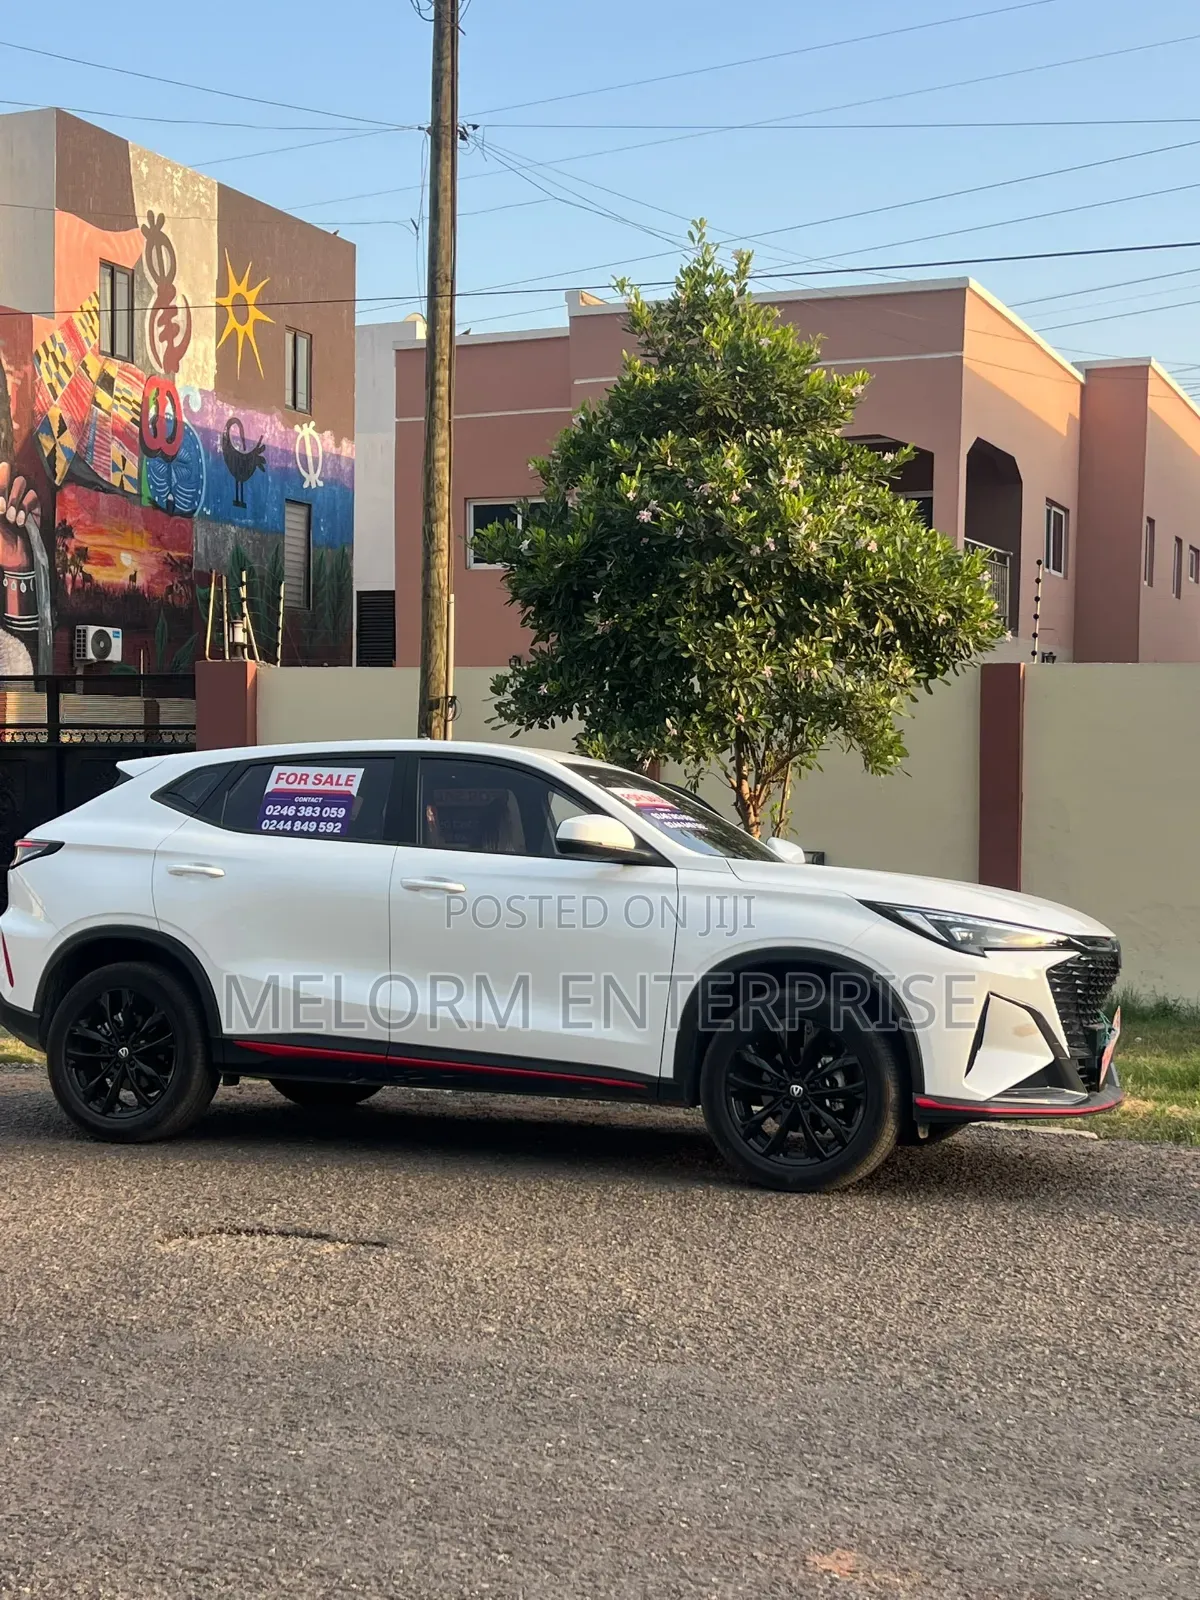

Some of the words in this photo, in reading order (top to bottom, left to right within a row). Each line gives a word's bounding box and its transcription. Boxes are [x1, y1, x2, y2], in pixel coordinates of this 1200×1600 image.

[275, 772, 310, 785] FOR
[312, 773, 356, 787] SALE
[265, 805, 296, 816] 0246
[297, 806, 320, 817] 383
[321, 807, 346, 818] 059
[261, 819, 292, 831] 0244
[293, 820, 317, 832] 849
[318, 822, 342, 833] 592
